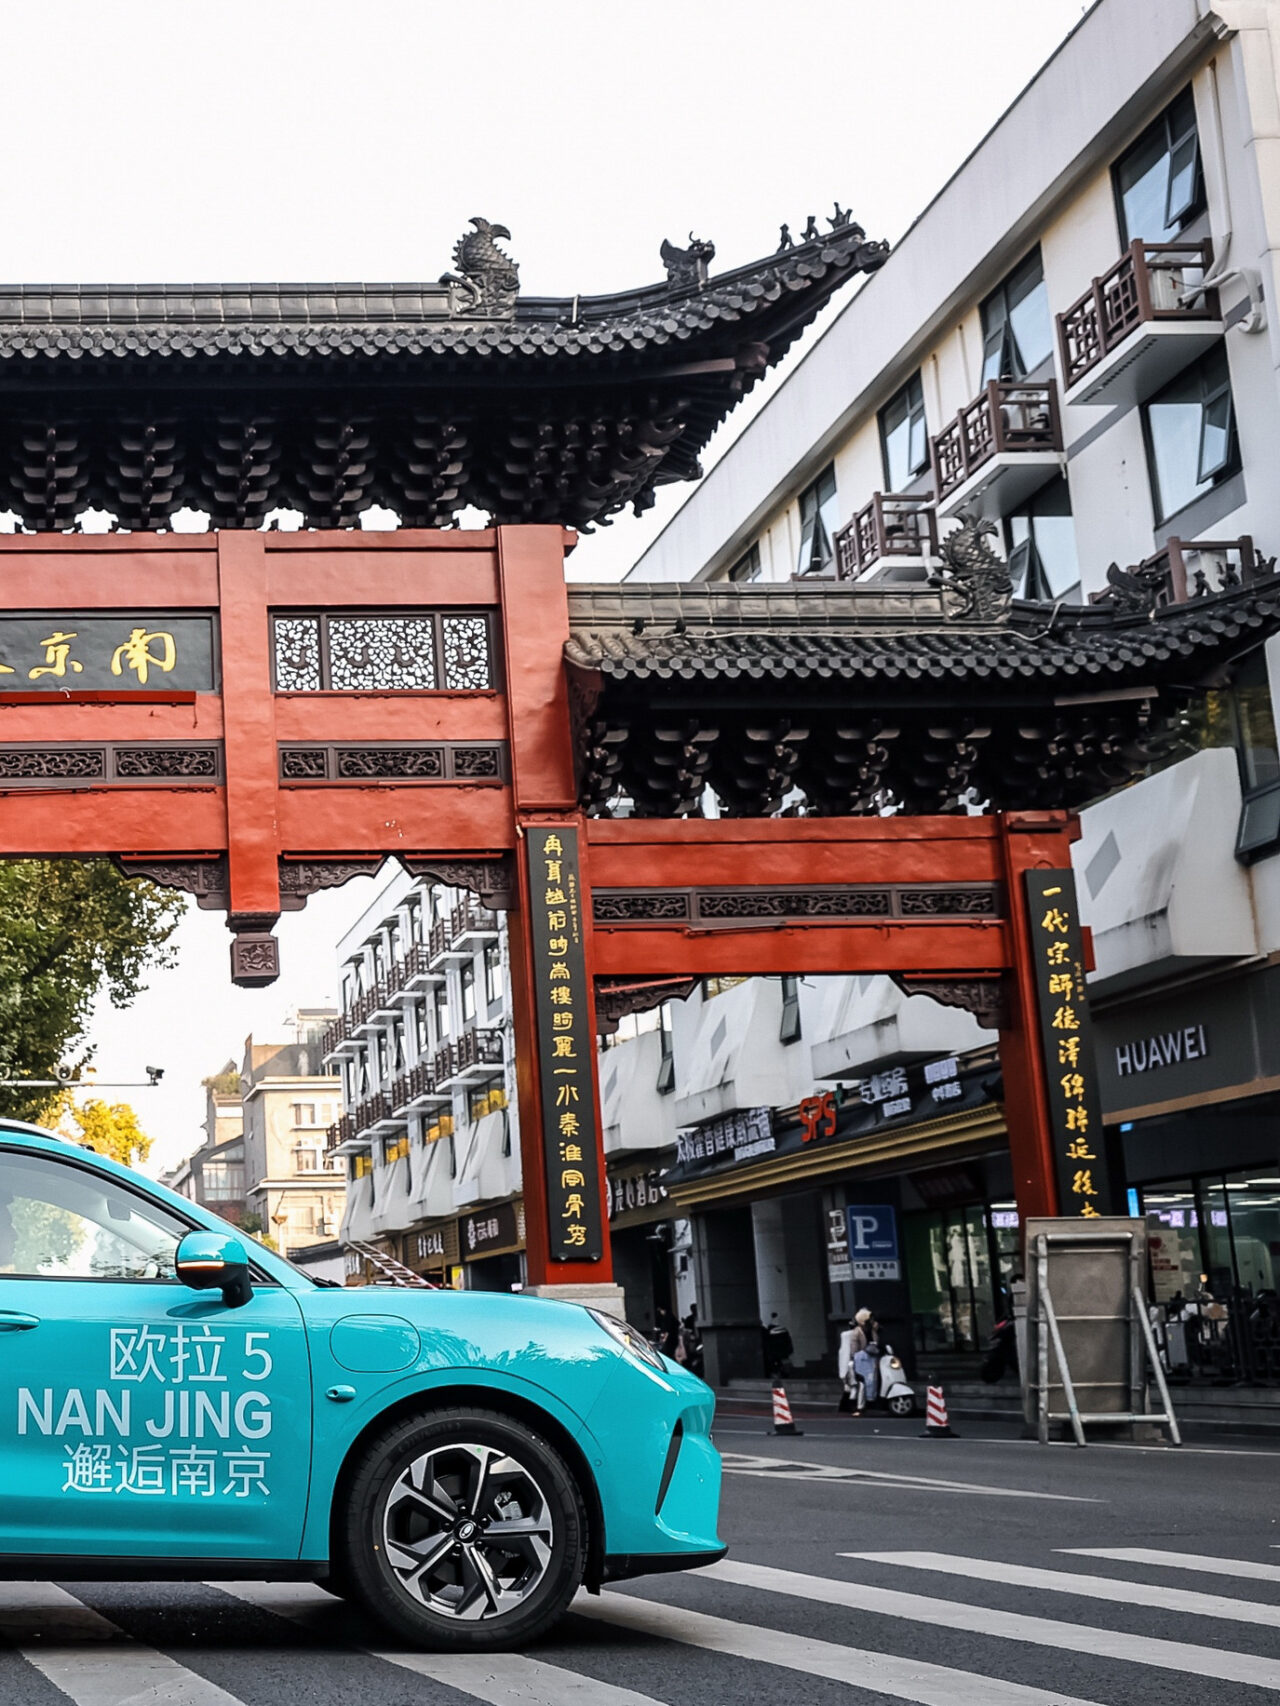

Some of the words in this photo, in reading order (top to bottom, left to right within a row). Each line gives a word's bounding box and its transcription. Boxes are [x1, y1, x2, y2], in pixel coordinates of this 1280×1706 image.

[1116, 1025, 1207, 1076] HUAWEI
[852, 1215, 879, 1249] P
[109, 1324, 228, 1383] 欧拉
[241, 1332, 273, 1380] 5
[17, 1387, 131, 1437] NAN
[144, 1389, 272, 1440] JING
[61, 1442, 271, 1498] 邂逅南京
